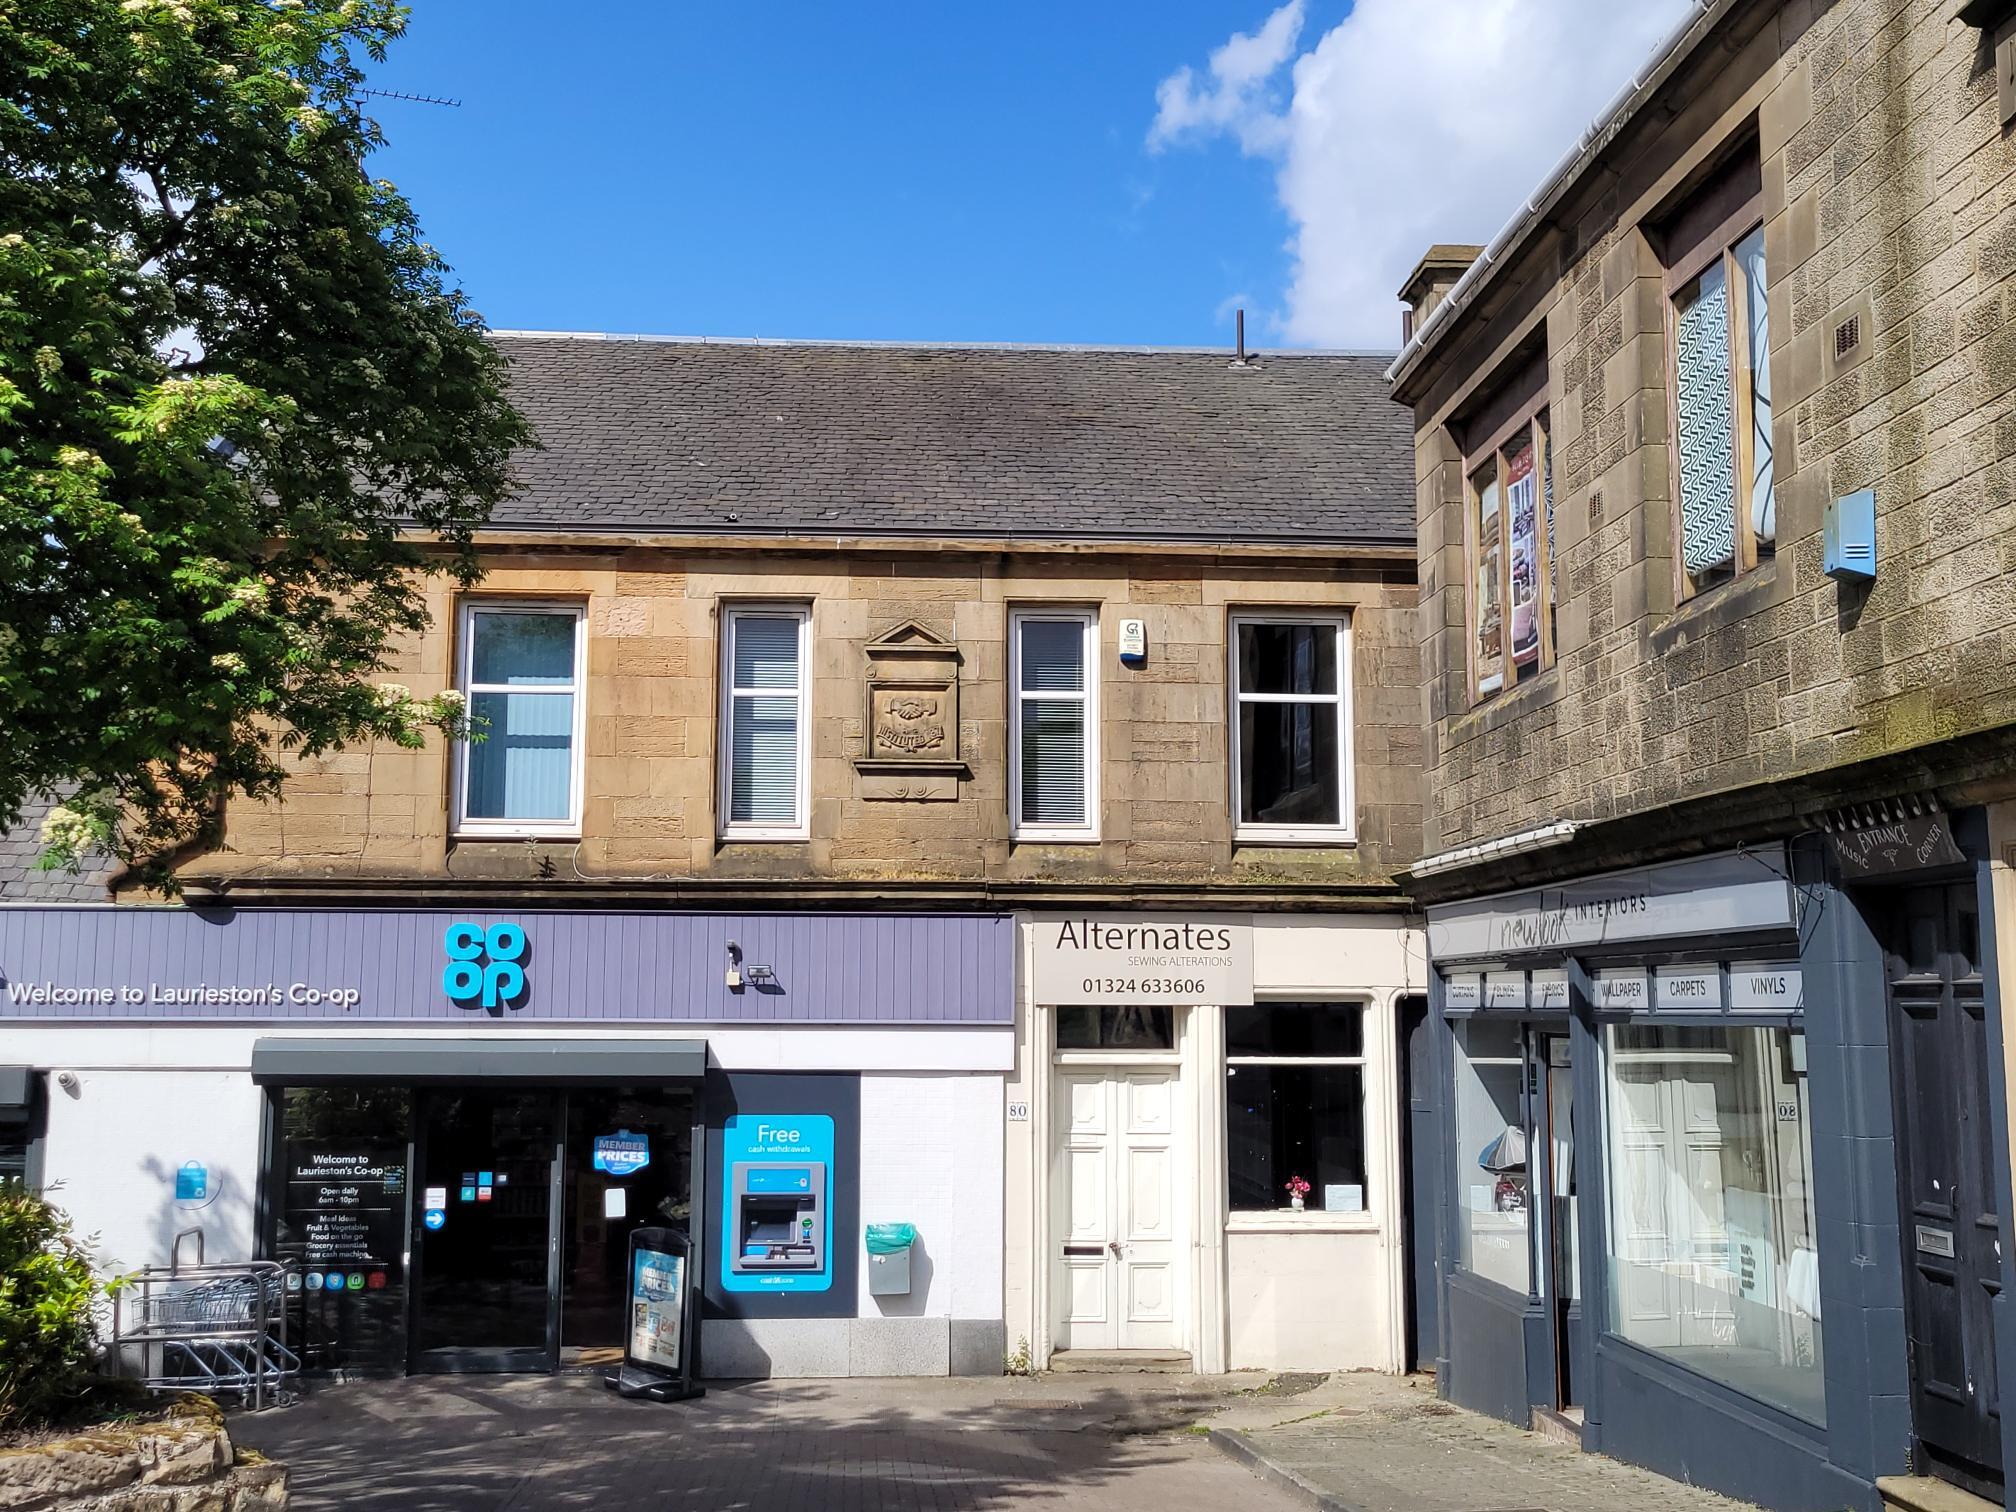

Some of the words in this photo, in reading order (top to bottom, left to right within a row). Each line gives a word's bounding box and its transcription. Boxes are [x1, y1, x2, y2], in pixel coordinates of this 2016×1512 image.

[1857, 824, 1912, 854] ENTRANCE
[1916, 823, 1943, 864] CORNER
[1575, 893, 1646, 920] INTERIORS
[1056, 918, 1231, 950] Alternates
[1128, 956, 1167, 967] SEWING
[1169, 956, 1233, 967] ALTERATIONS
[1083, 978, 1136, 993] 01324
[1141, 978, 1206, 993] 633606
[1601, 982, 1642, 998] WALLPAPER
[1670, 980, 1706, 996] CARPETS
[1751, 977, 1786, 994] VINYLS
[7, 981, 117, 1003] Welcome
[121, 984, 144, 1003] to
[152, 982, 283, 1003] Laurieston's
[289, 982, 359, 1009] Co-op
[1009, 1105, 1027, 1117] 80
[758, 1124, 801, 1143] Free
[598, 1139, 645, 1151] MEMBER
[766, 1144, 811, 1152] withdrawals
[313, 1155, 356, 1164] Welcome
[359, 1155, 368, 1164] to
[598, 1149, 646, 1162] PRICES
[297, 1167, 352, 1176] Laurieston's
[354, 1166, 383, 1177] Co-op
[321, 1187, 341, 1197] Open
[342, 1187, 359, 1197] daily
[340, 1196, 359, 1205] 10pm
[331, 1224, 369, 1232] Vegetables
[306, 1242, 333, 1250] Grocery
[335, 1241, 367, 1249] essentials
[322, 1250, 337, 1258] cash
